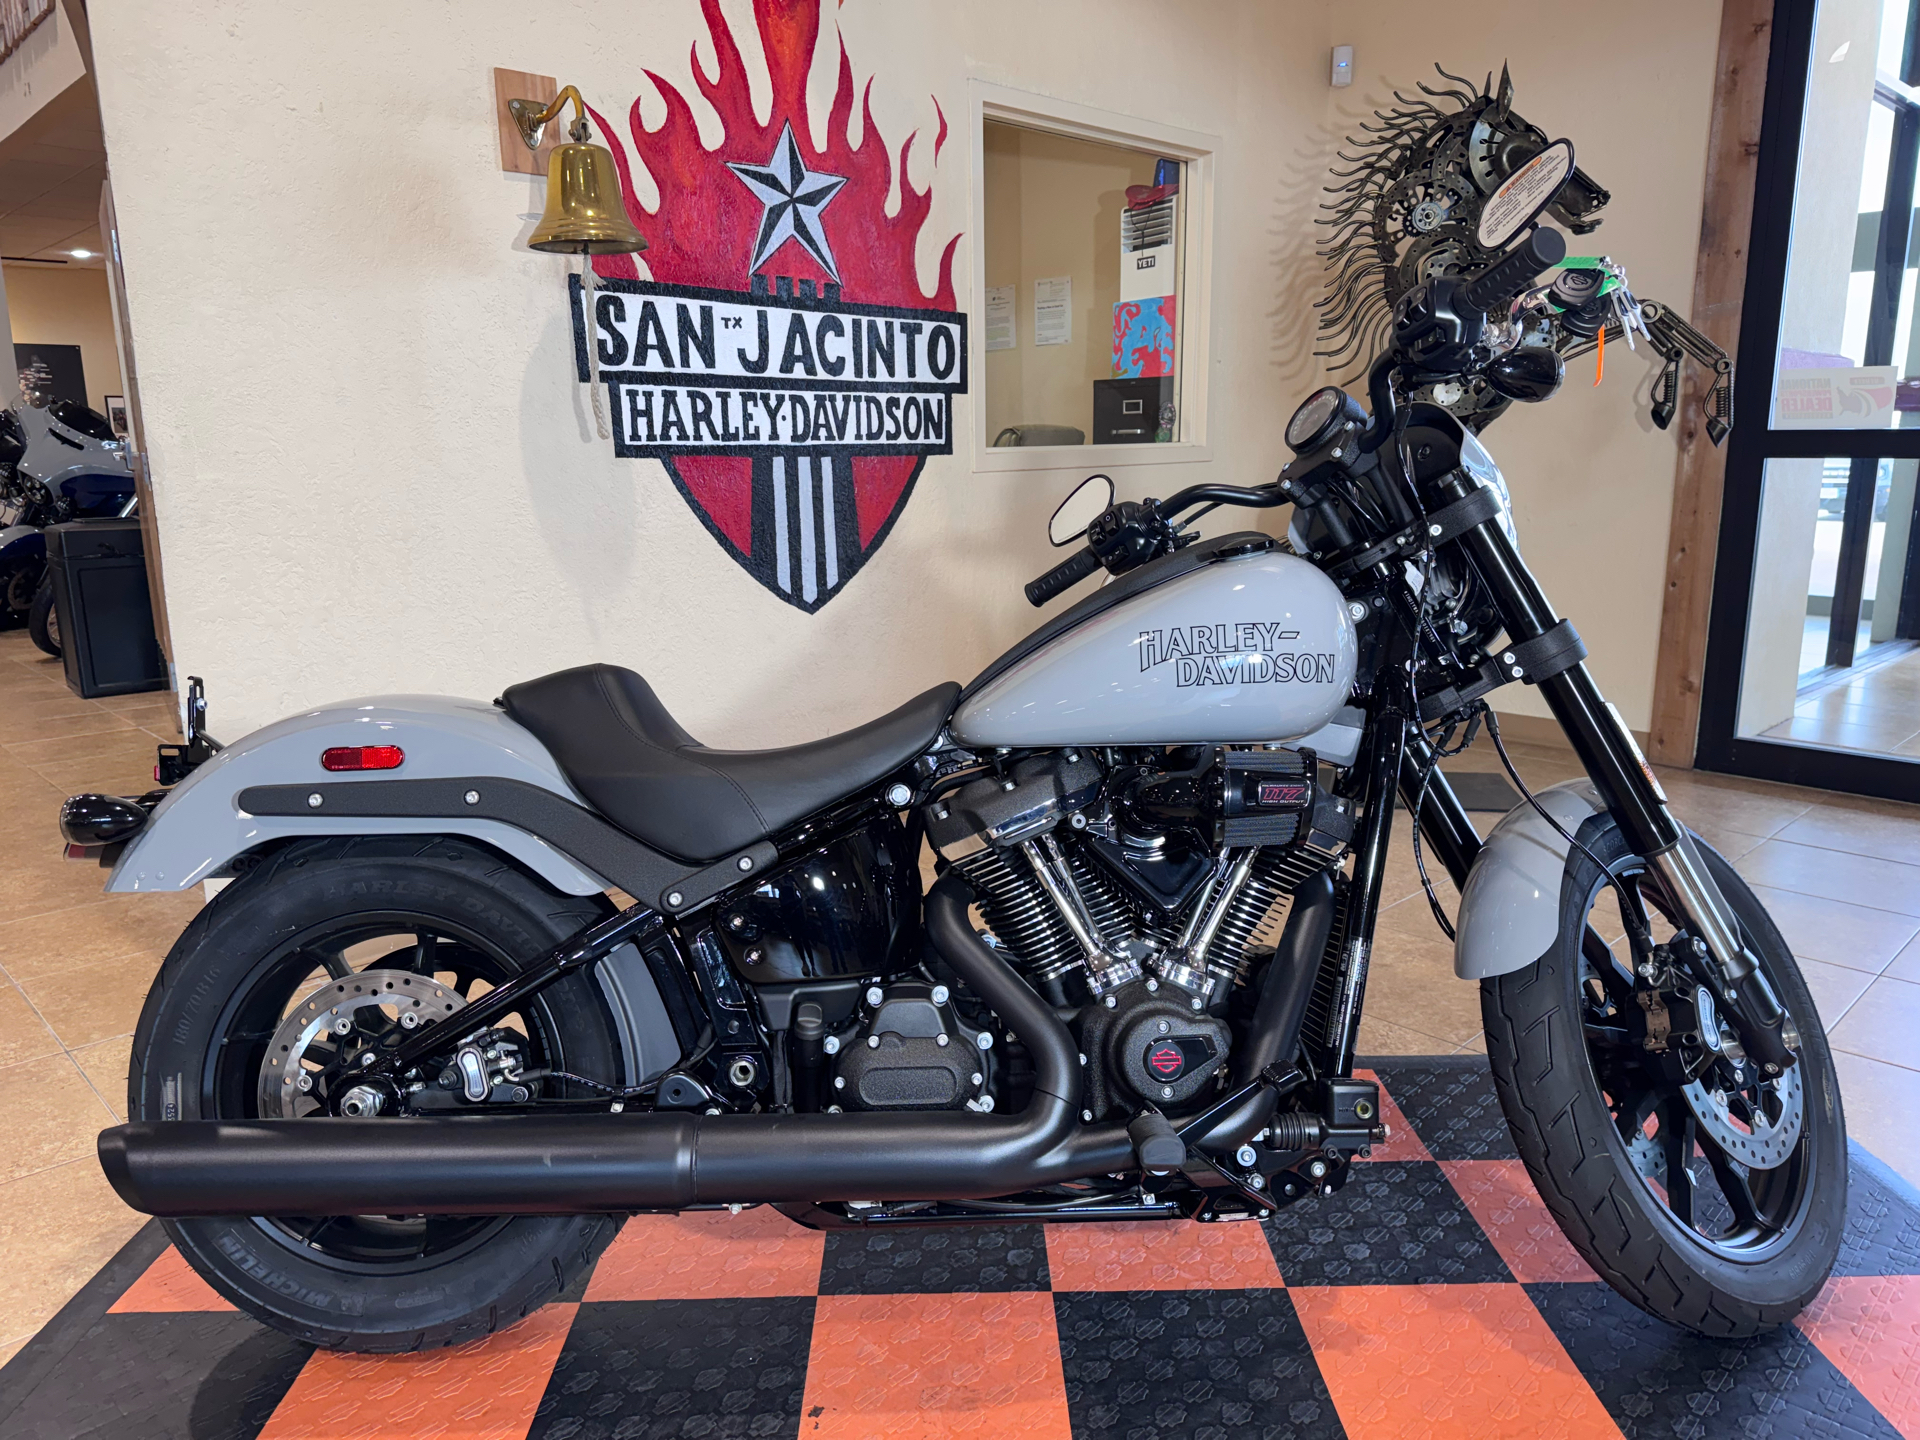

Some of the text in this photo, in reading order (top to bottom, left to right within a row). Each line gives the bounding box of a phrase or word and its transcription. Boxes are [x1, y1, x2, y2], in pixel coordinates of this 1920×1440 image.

[1137, 257, 1155, 269] YETI
[596, 294, 715, 369] SAN
[721, 316, 742, 330] TX
[737, 310, 955, 380] JACINTO
[1139, 622, 1300, 673] HARLEY-
[1176, 653, 1335, 687] DAVIDSON
[1263, 788, 1305, 800] 117
[219, 1235, 334, 1307] MICHELIN
